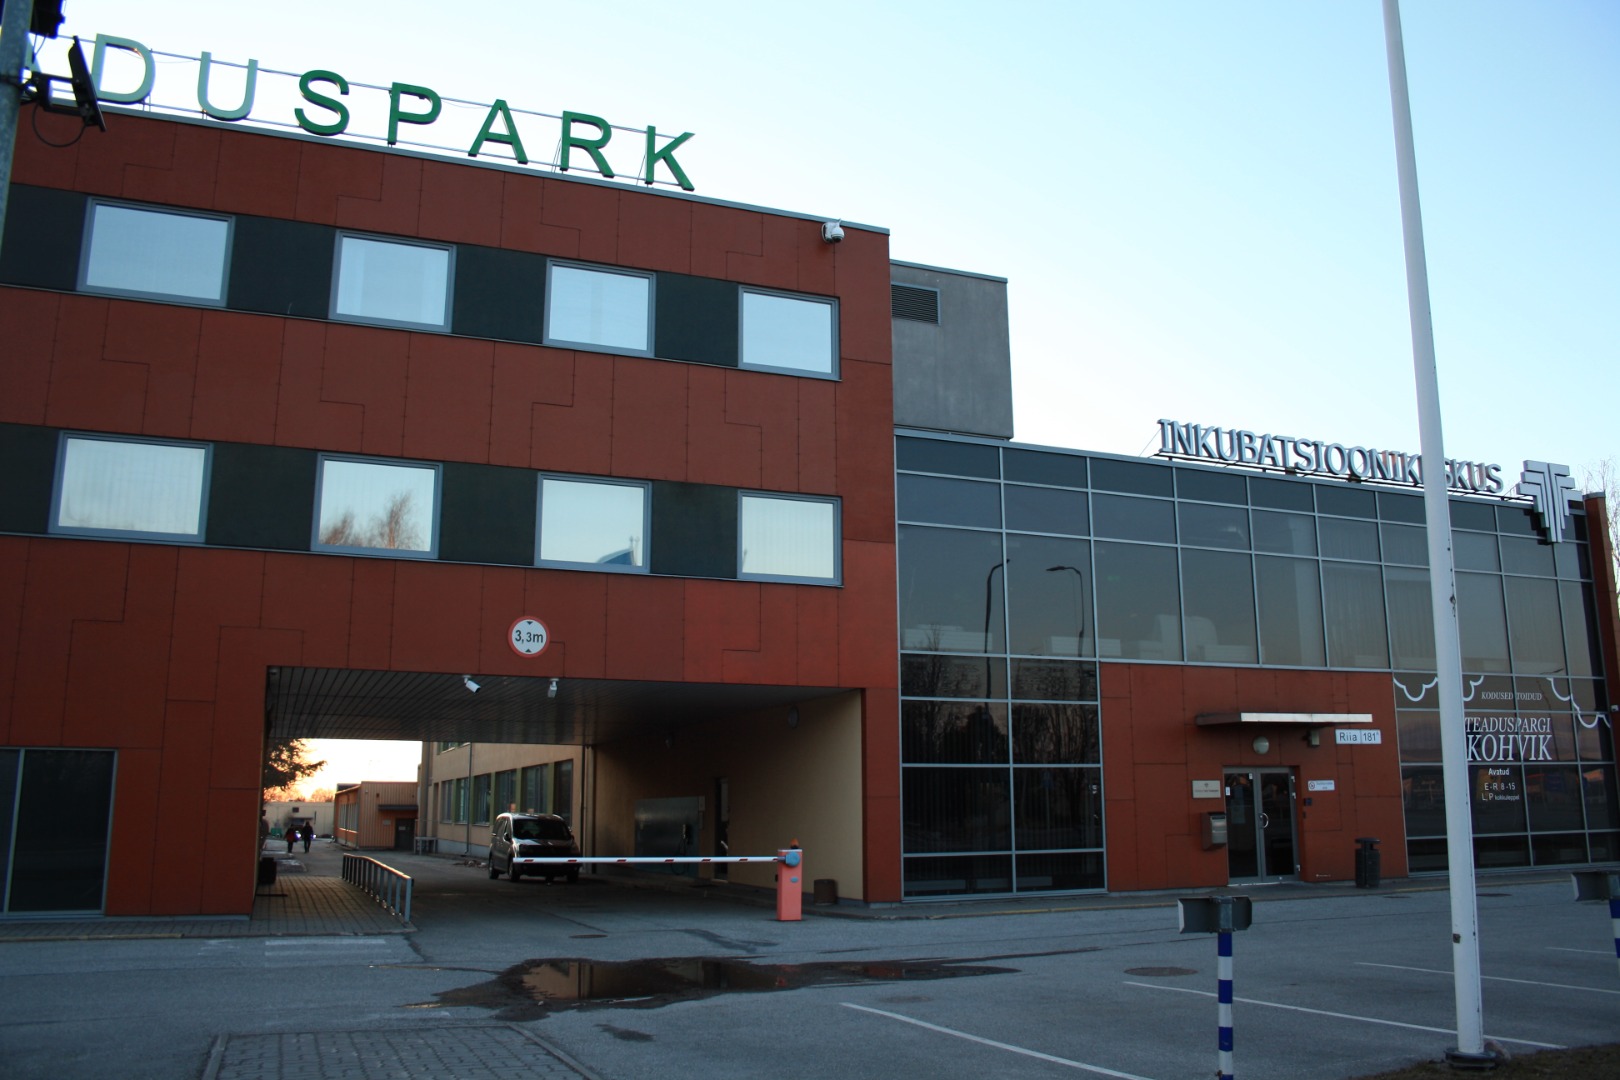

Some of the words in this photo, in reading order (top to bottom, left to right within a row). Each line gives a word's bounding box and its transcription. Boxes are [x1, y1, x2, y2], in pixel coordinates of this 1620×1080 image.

[1157, 418, 1504, 493] INKUBATSIOONIKSKUS
[515, 629, 544, 645] 3,3m
[1481, 691, 1514, 700] KODUSED
[1516, 692, 1542, 700] TOIDUD
[1464, 717, 1551, 732] TEADUSPARGI
[1339, 731, 1358, 742] Riia
[1467, 734, 1552, 761] KOHVIK
[1488, 767, 1510, 776] Avatud
